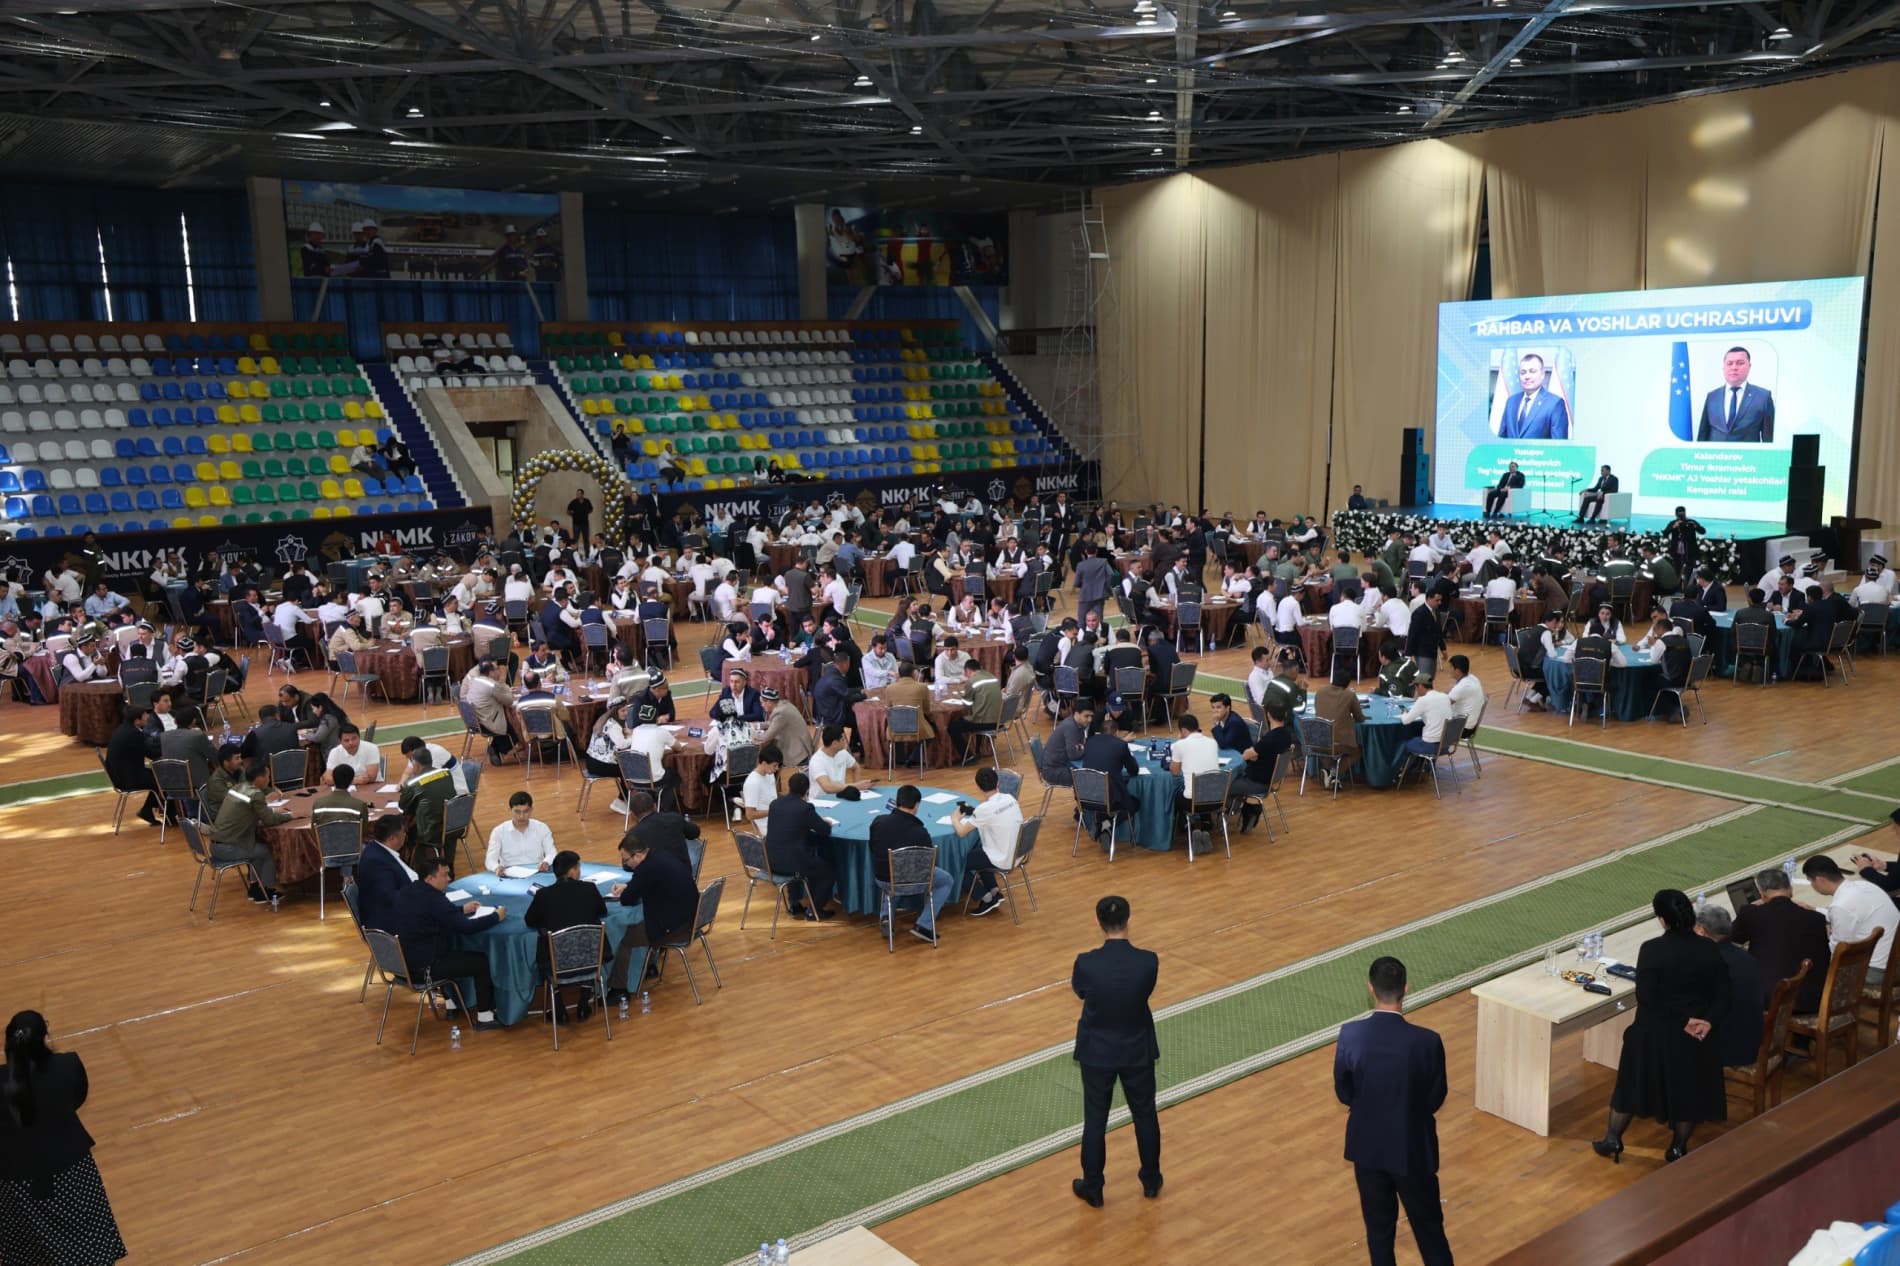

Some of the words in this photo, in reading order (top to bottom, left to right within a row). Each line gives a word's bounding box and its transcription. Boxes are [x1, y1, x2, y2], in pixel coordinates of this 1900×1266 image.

[1476, 319, 1546, 337] RAHBAR
[1549, 317, 1573, 333] VA
[1577, 314, 1661, 332] YOSHLAR
[1666, 306, 1801, 328] UCHRASHUVI
[1680, 463, 1705, 471] Timur
[1036, 474, 1078, 490] NKMK
[881, 486, 930, 504] NKMK
